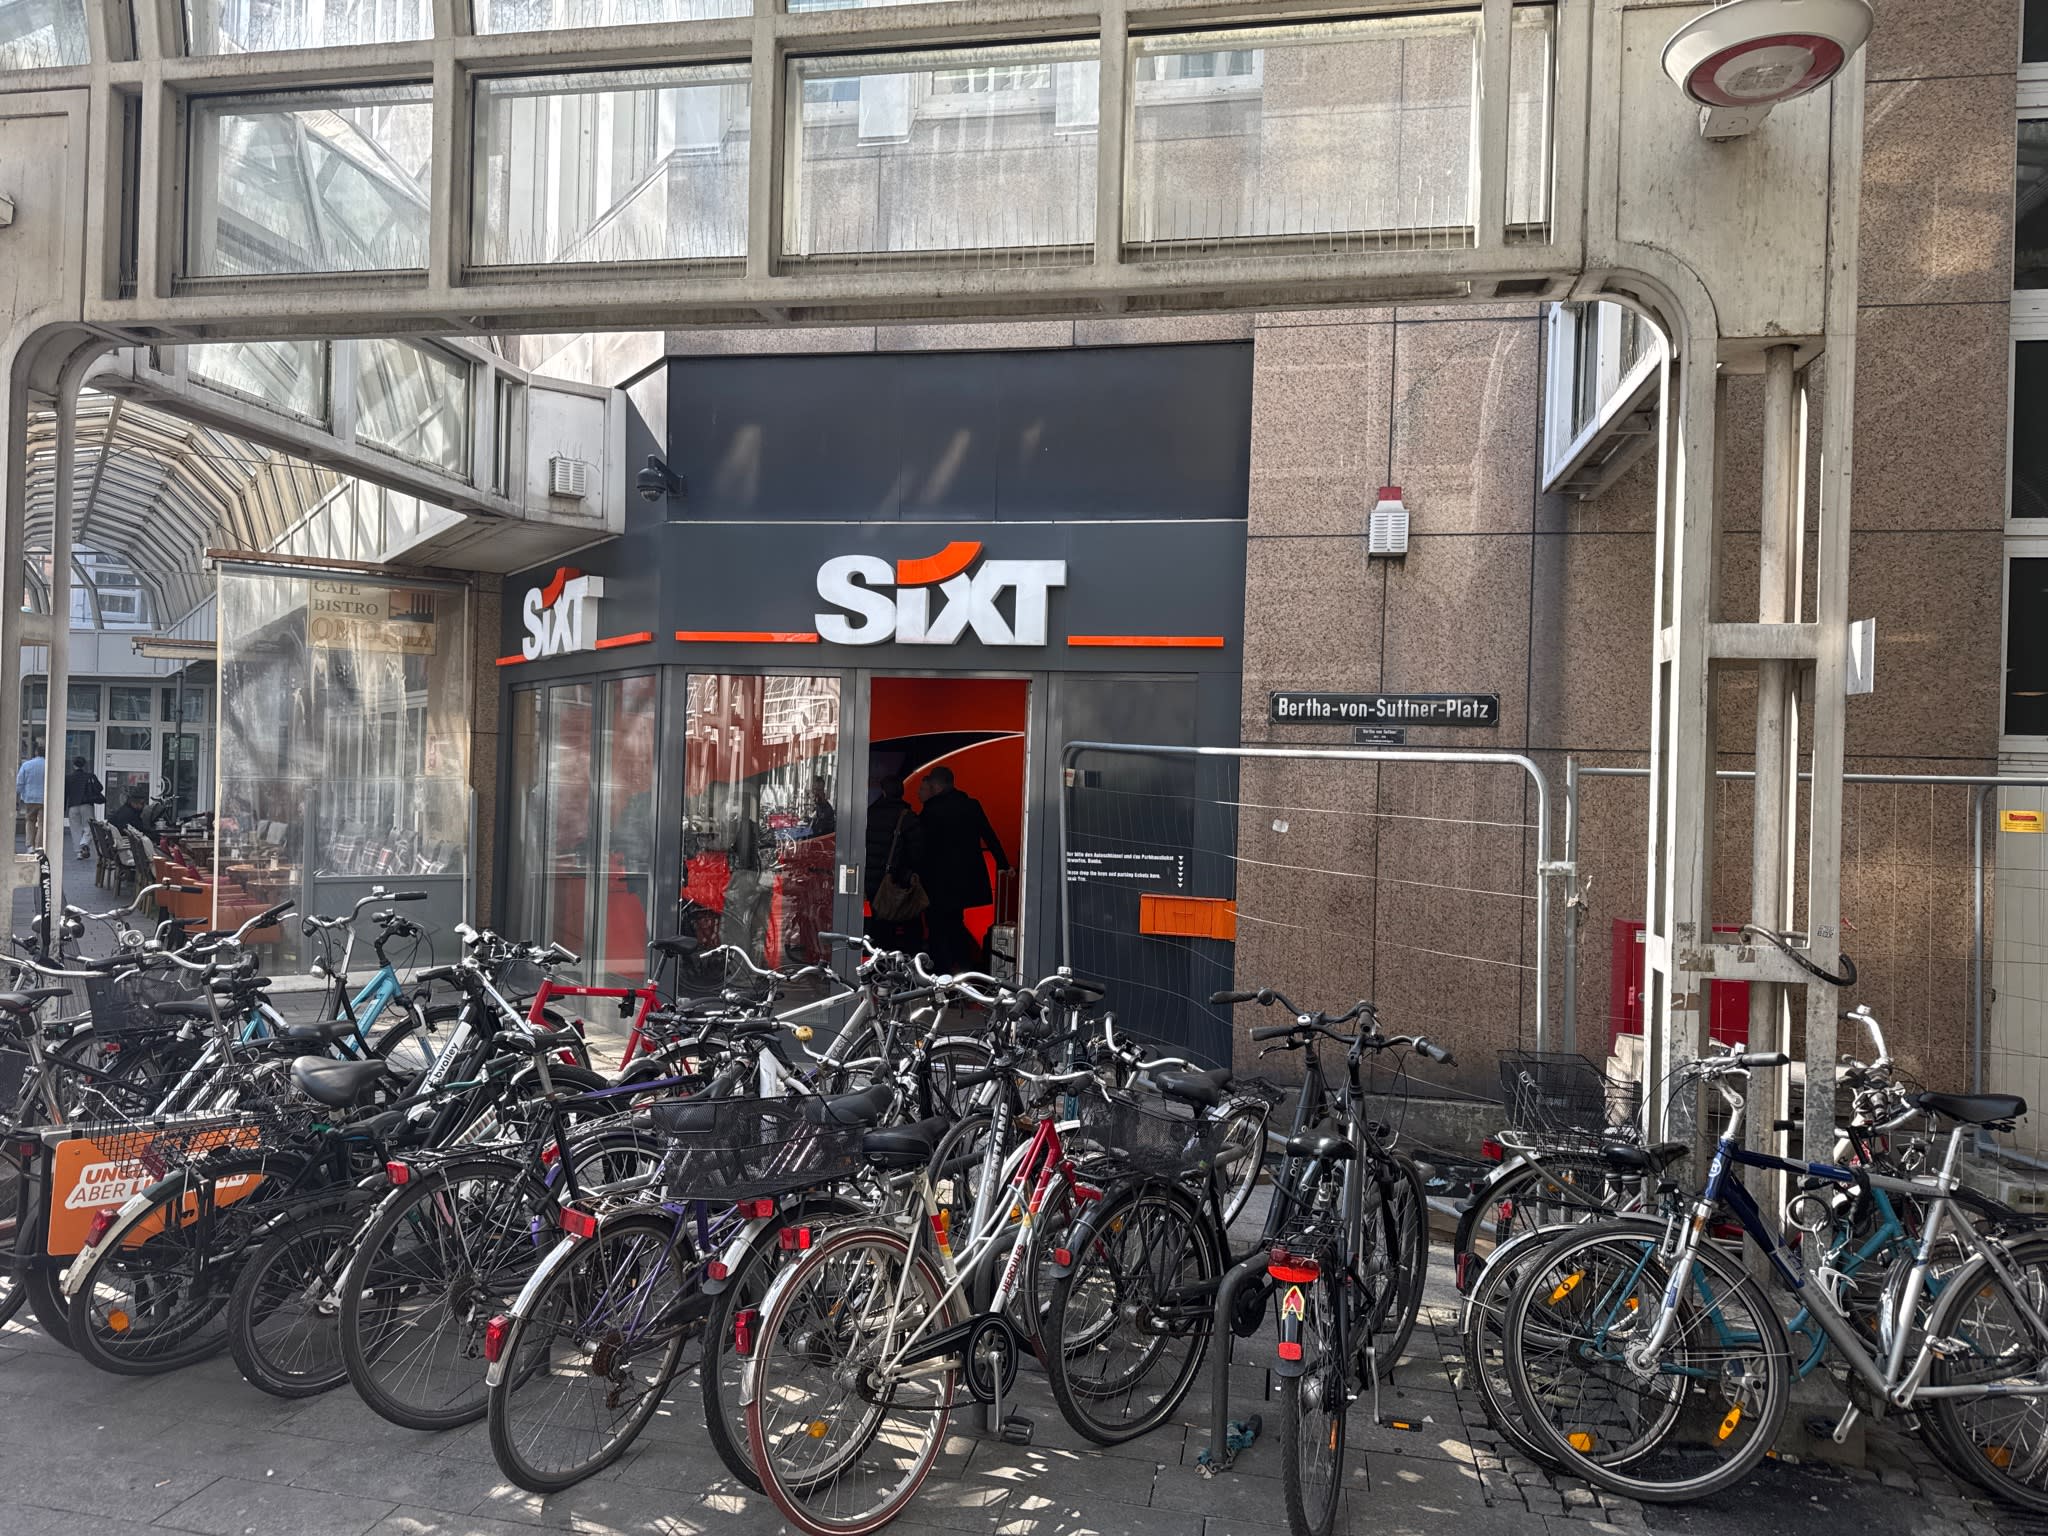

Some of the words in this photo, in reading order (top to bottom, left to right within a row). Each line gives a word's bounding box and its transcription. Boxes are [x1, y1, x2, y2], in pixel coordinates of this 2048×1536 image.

[314, 599, 379, 616] BISTRO
[1278, 698, 1489, 719] Bertha-von-Suttner-Platz
[72, 1181, 126, 1204] ABER
[1002, 1243, 1025, 1293] HERCULES
